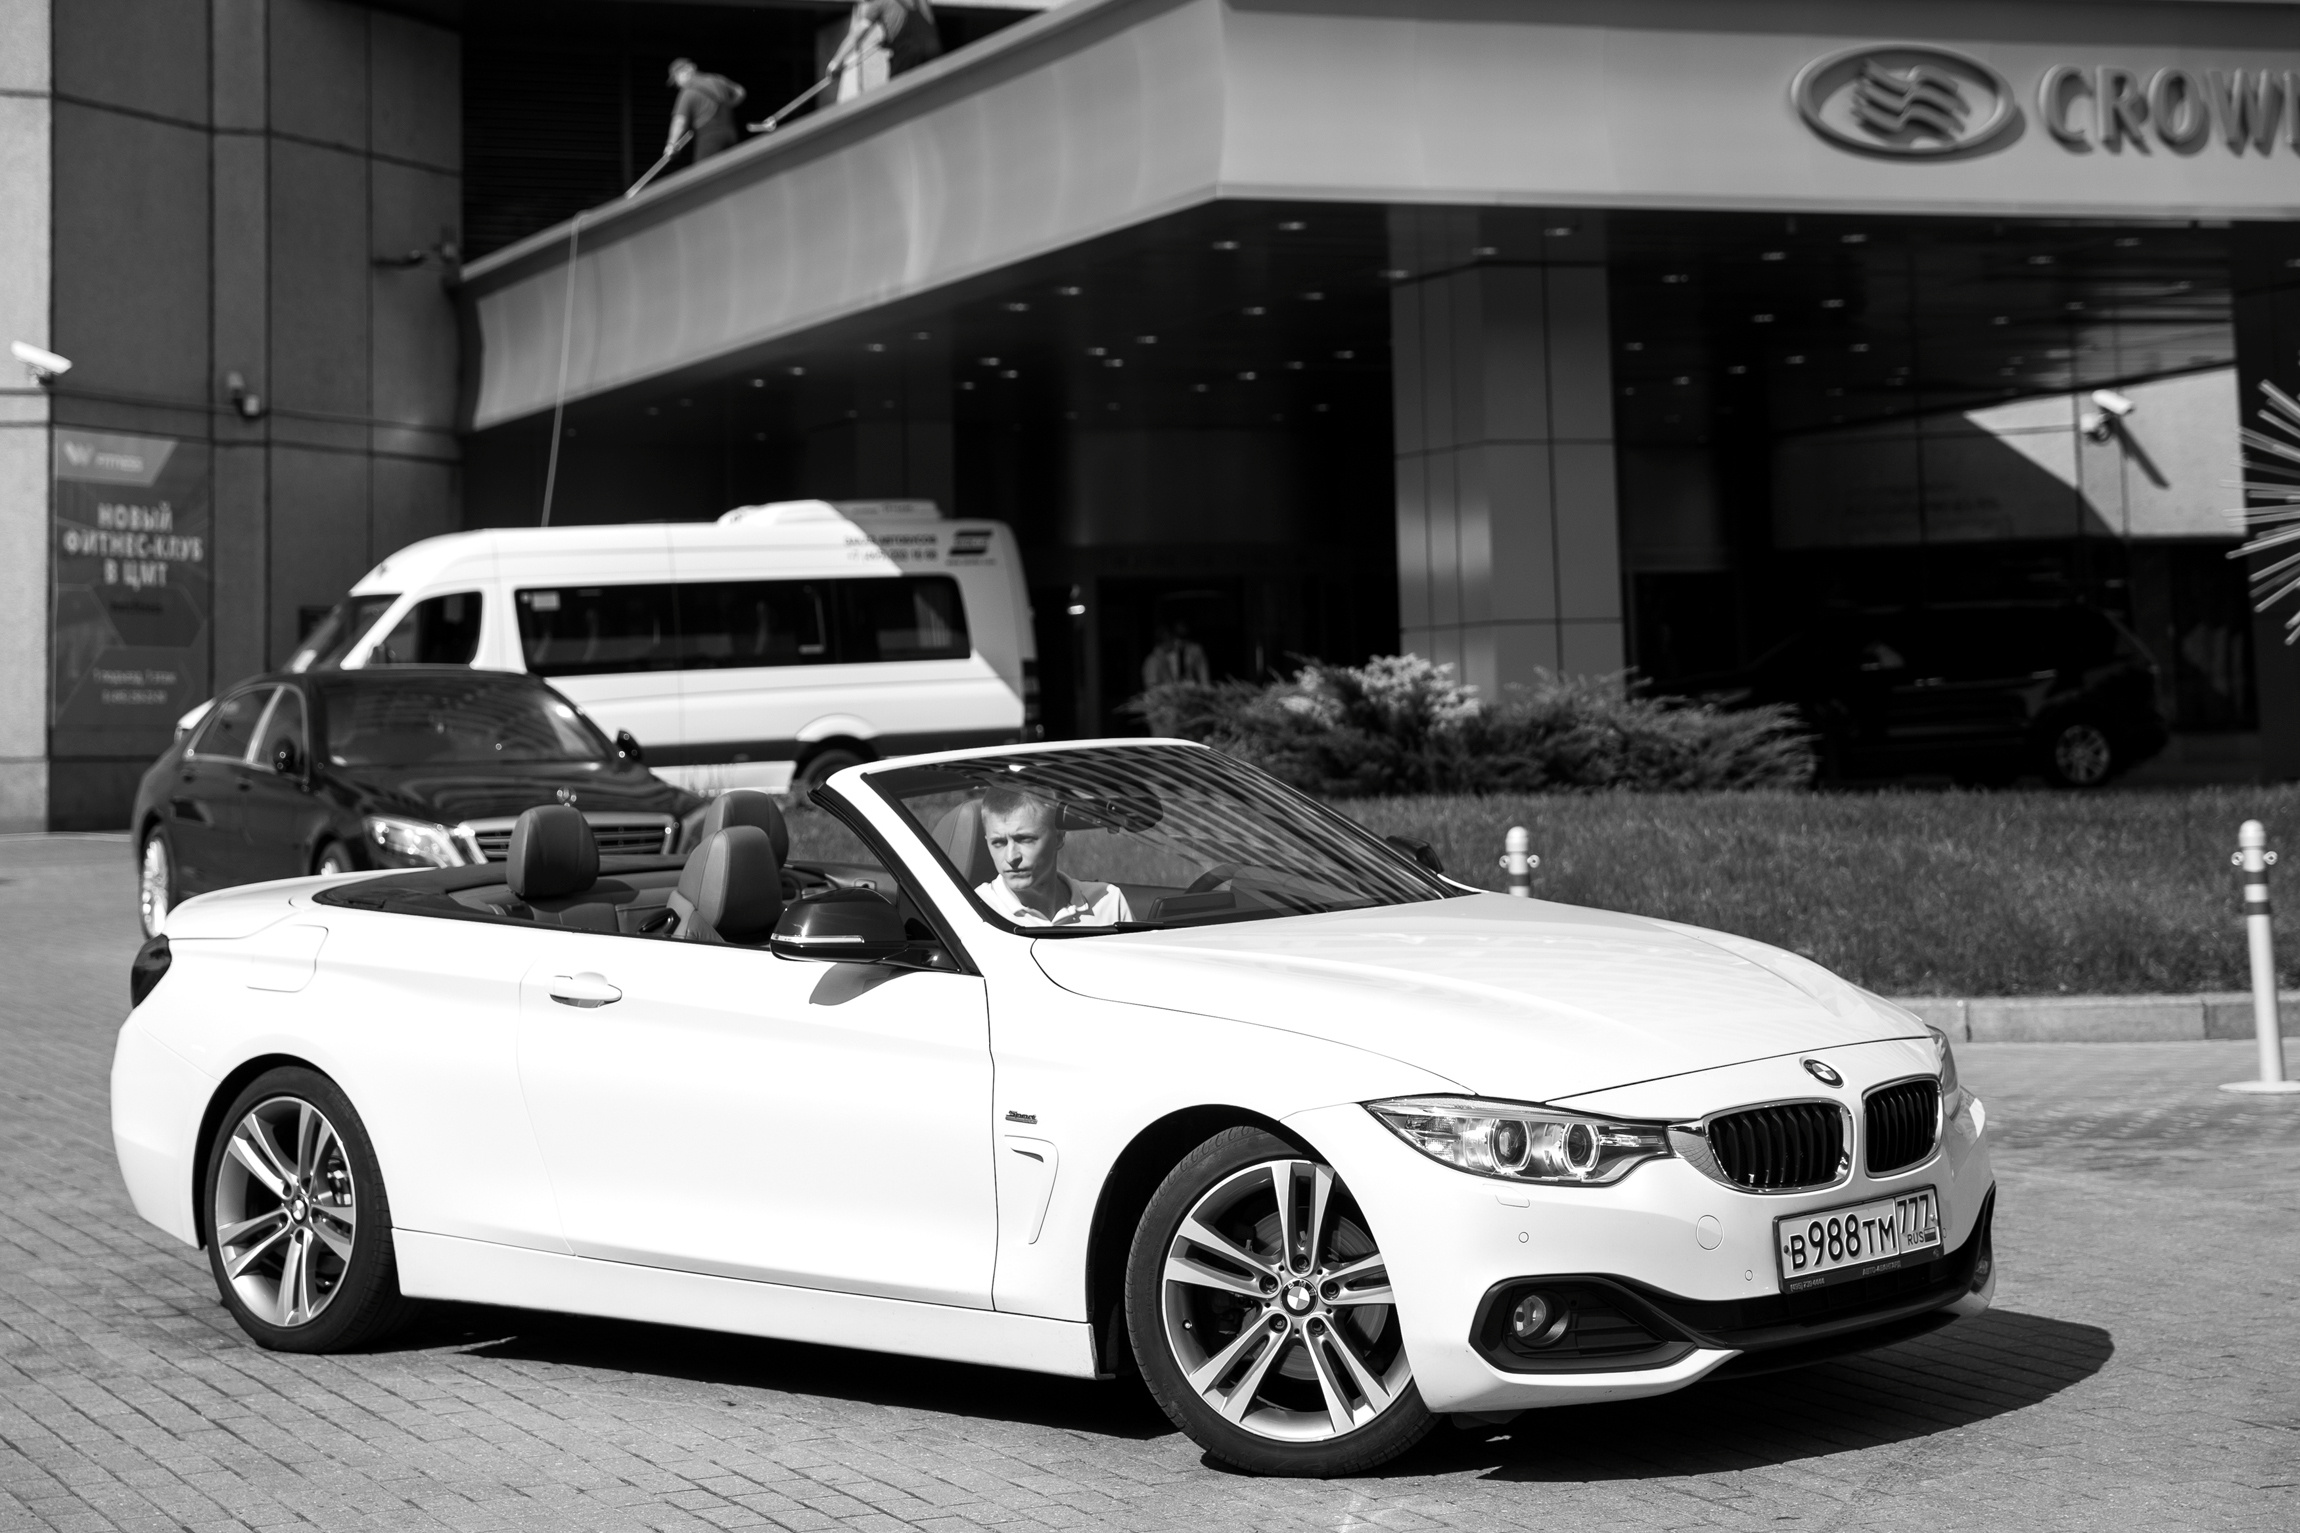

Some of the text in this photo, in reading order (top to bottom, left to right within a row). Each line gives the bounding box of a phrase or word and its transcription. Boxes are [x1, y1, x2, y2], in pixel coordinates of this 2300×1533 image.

[97, 501, 173, 533] НОВЫЙ
[63, 529, 203, 562] ФИТНЕС-КЛУБ
[1896, 1193, 1929, 1234] 777
[1907, 1230, 1924, 1246] RUS
